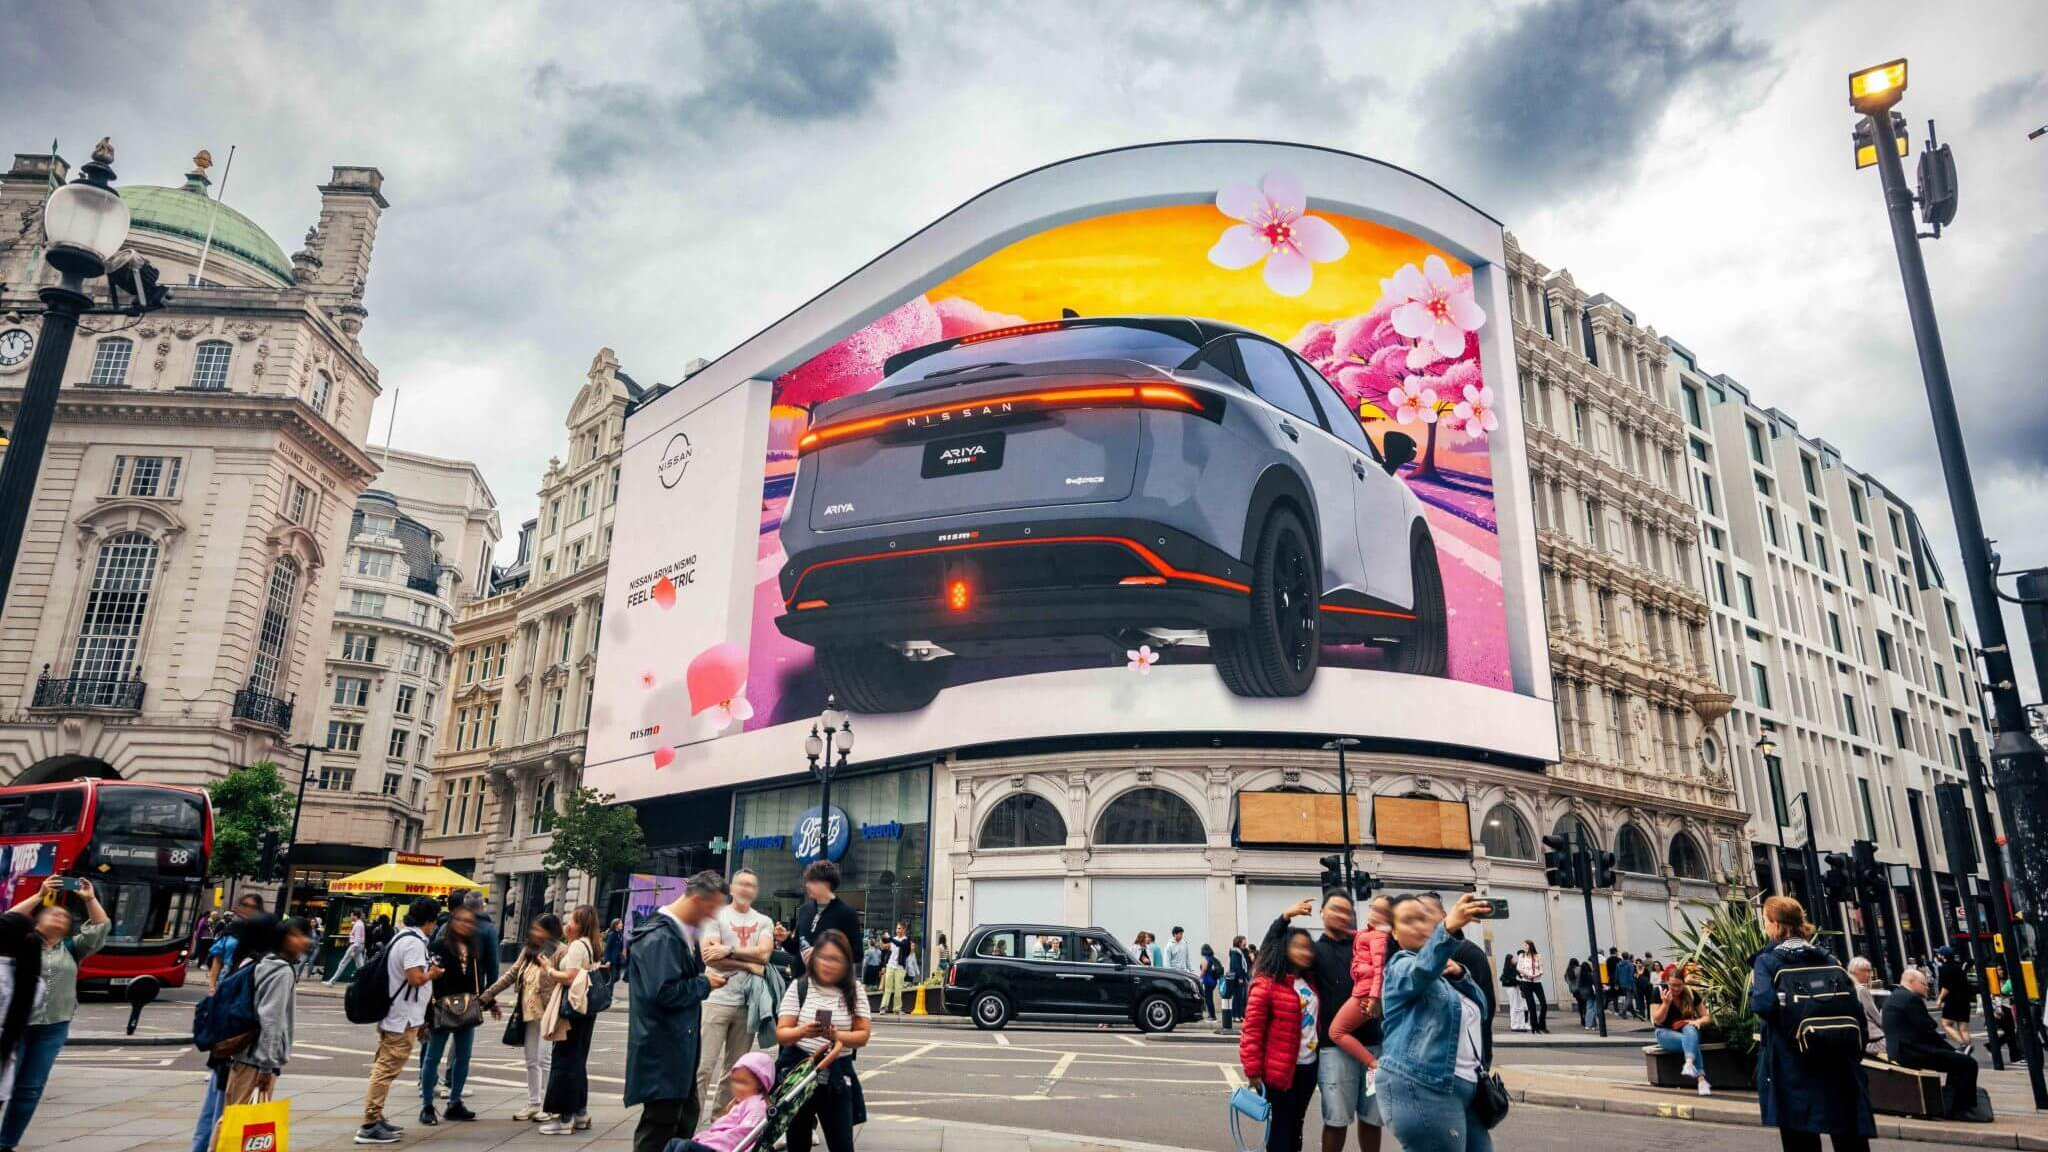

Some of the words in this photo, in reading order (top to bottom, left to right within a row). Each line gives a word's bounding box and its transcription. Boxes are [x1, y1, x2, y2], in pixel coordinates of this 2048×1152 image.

[907, 402, 1012, 427] NISSAN
[658, 448, 693, 473] NISSAN
[939, 445, 987, 460] ARIYA
[947, 456, 977, 465] nismo
[278, 440, 303, 465] ALLIANCE
[320, 472, 336, 490] OFFICE
[824, 502, 855, 516] ARIYA
[938, 530, 981, 542] nismo
[629, 573, 653, 591] NISSAN
[653, 565, 673, 580] ARIYA
[674, 554, 697, 572] NISMO
[627, 590, 648, 609] FEEL
[650, 569, 696, 600] ETRIC
[629, 725, 660, 740] nismo
[863, 820, 904, 840] beauty
[735, 834, 785, 852] pharmacy
[169, 849, 189, 864] 88
[330, 882, 347, 891] HOT
[349, 882, 363, 891] DOG
[365, 882, 384, 892] SPOT
[405, 884, 426, 893] HOT
[427, 885, 447, 894] DOG
[245, 1133, 274, 1151] LEGO
